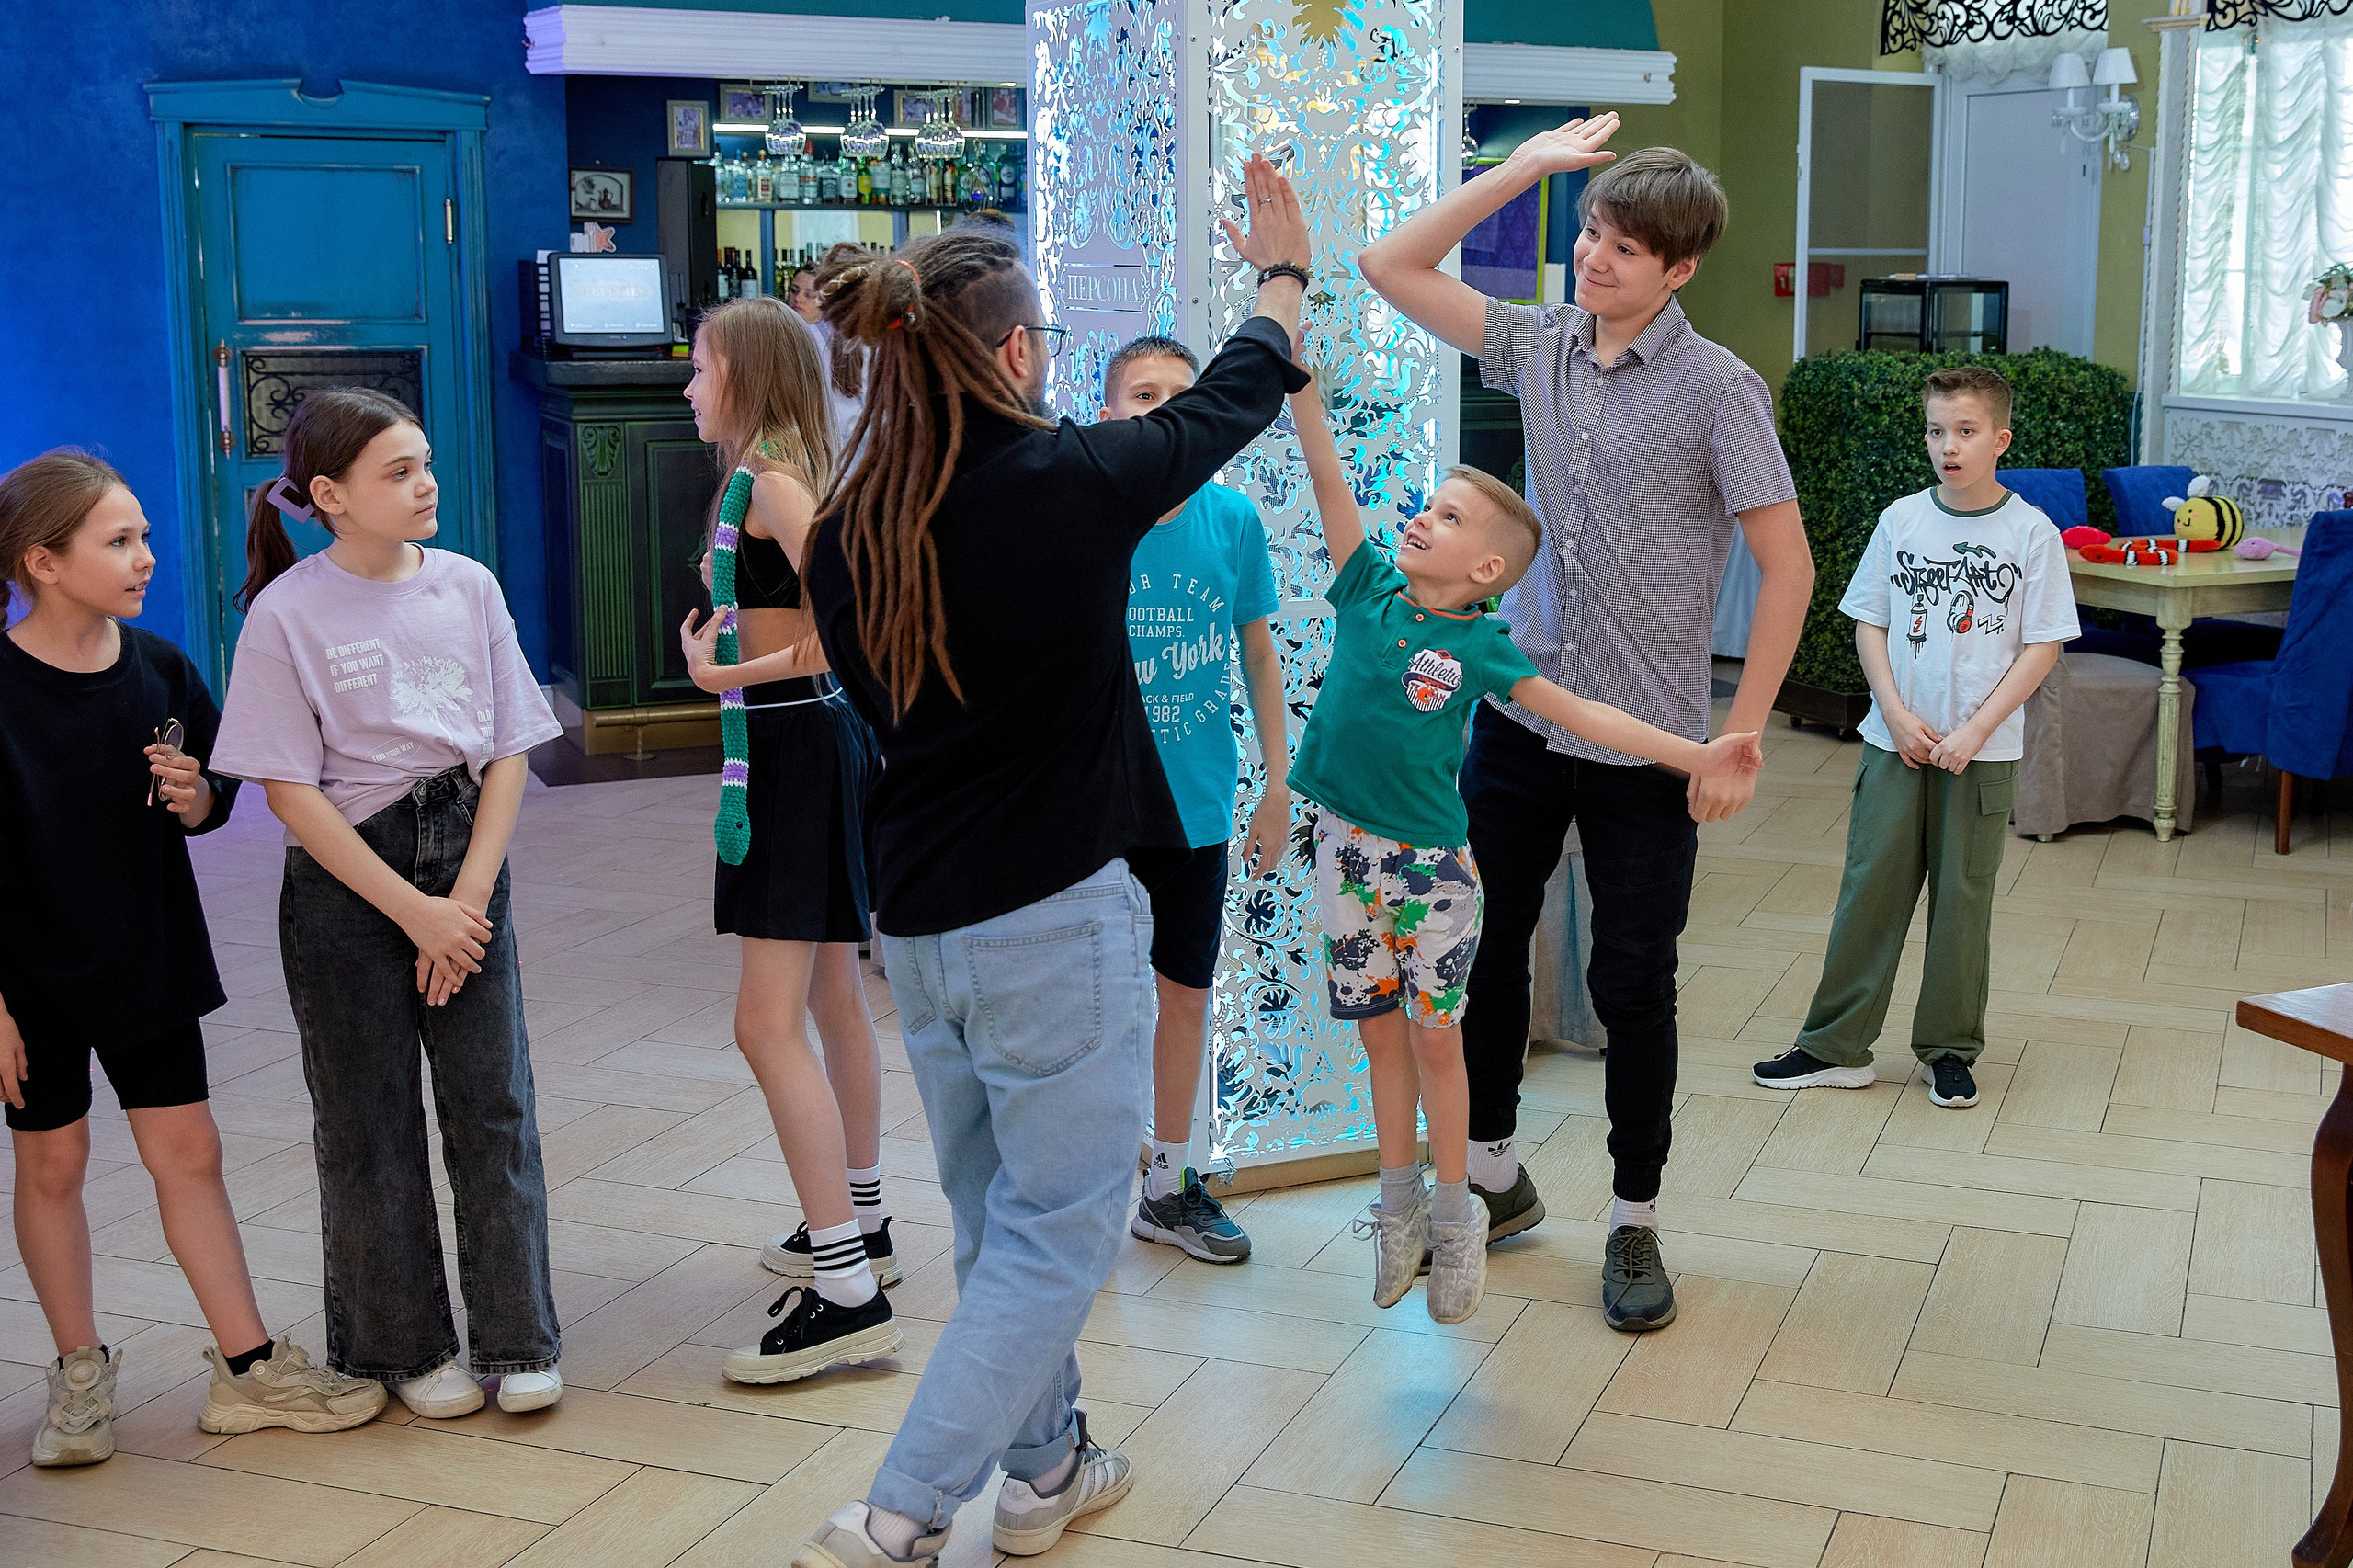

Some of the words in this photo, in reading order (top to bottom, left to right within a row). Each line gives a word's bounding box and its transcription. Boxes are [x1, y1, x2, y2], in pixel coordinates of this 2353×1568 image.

[1067, 274, 1141, 303] ПЕРСОНА
[1172, 573, 1225, 613] TEAM
[1128, 606, 1195, 623] OOTBALL
[1128, 624, 1186, 638] CHAMPS.
[325, 646, 339, 661] BE
[337, 638, 381, 658] DIFFERENT
[1161, 621, 1227, 680] York
[329, 664, 339, 676] IF
[339, 659, 359, 675] YOU
[358, 653, 385, 671] WANT
[1409, 652, 1462, 686] Athletic
[333, 673, 378, 694] DIFFERENT
[1161, 694, 1169, 704] &
[1171, 692, 1195, 704] FIELD
[372, 752, 387, 764] FIND
[384, 746, 402, 757] YOUR
[400, 741, 415, 753] WAY
